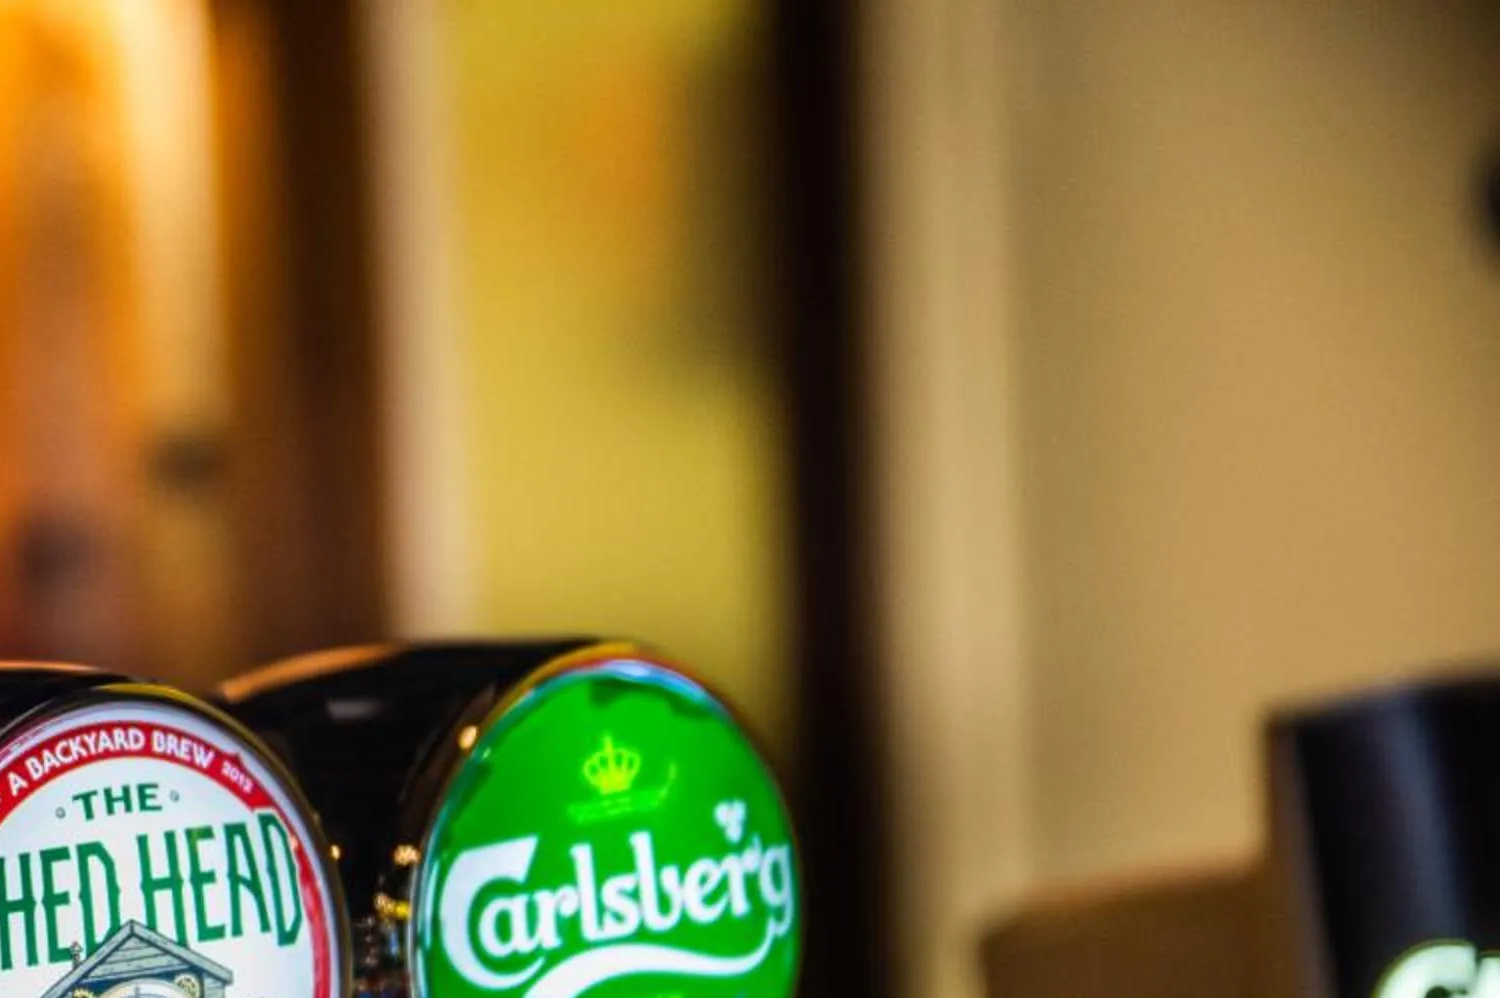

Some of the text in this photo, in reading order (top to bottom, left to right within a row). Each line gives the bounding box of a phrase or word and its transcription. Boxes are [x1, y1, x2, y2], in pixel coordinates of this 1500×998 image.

[6, 771, 29, 797] A
[24, 727, 145, 781] BACKYARD
[152, 730, 215, 769] BREW
[71, 783, 163, 822] THE
[136, 807, 301, 949] HEAD
[440, 830, 793, 992] Carlsberg
